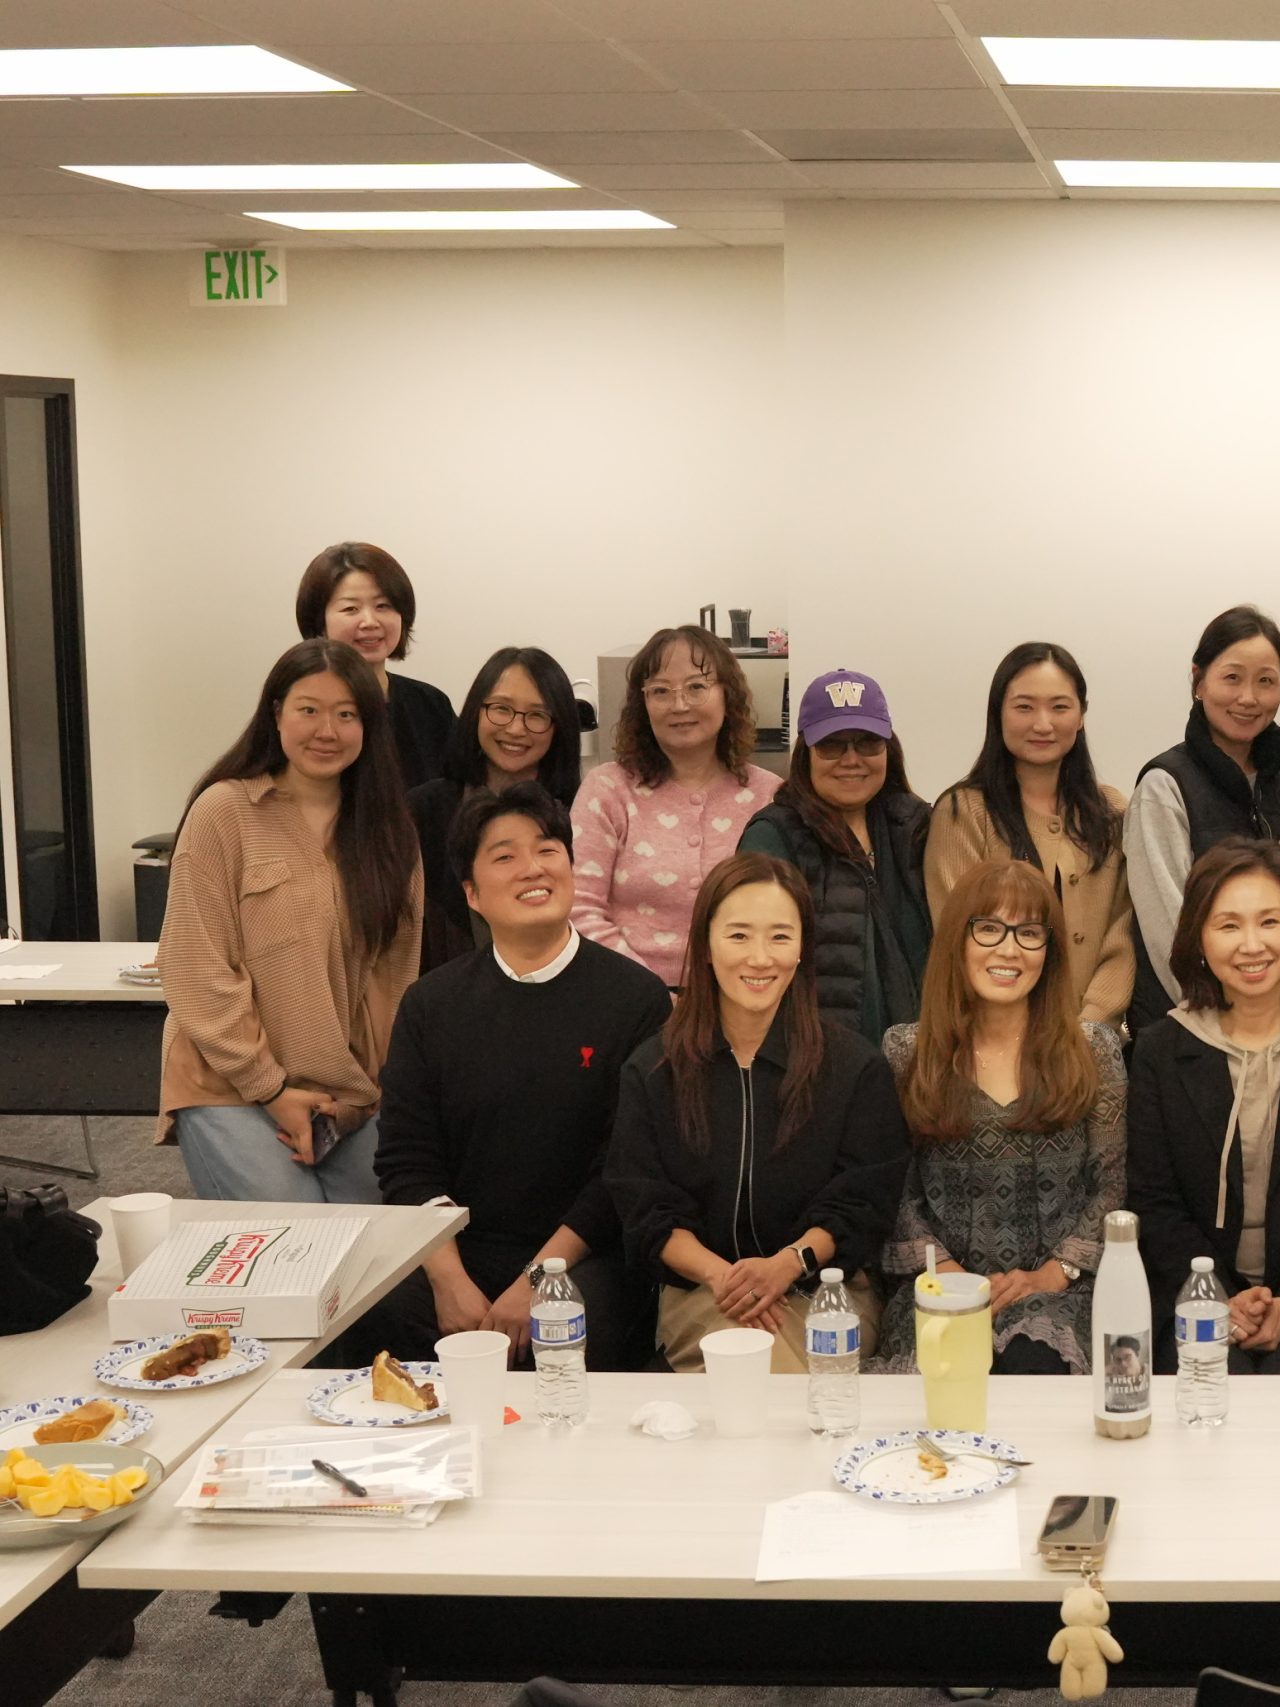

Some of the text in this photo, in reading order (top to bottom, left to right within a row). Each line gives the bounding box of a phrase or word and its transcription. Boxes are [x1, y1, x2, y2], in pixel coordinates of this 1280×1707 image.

[205, 250, 266, 299] EXIT
[825, 681, 865, 707] W
[219, 1234, 271, 1259] Krispy
[204, 1259, 249, 1284] Kreme
[187, 1312, 241, 1325] Krispy Kreme
